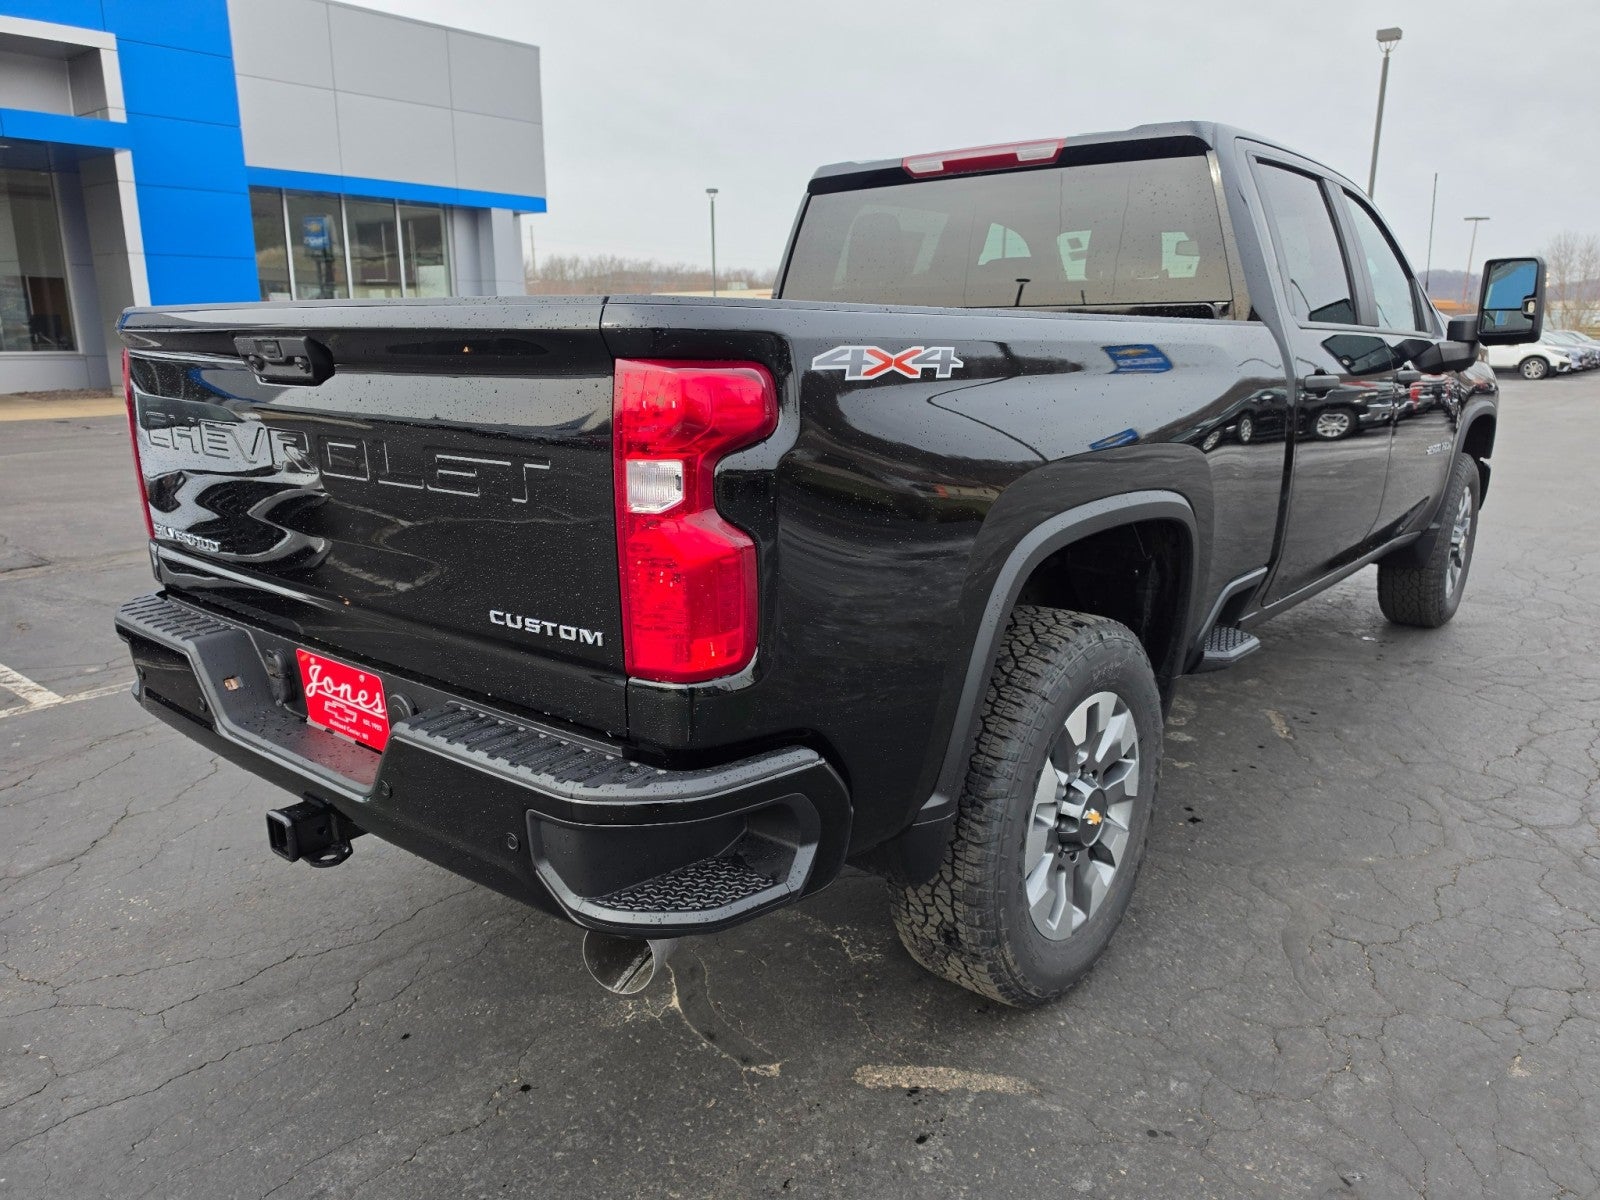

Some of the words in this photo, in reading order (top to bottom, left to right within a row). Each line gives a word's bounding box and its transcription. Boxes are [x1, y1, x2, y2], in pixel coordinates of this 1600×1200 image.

[146, 411, 550, 504] CHEVROLET
[489, 609, 604, 647] CUSTOM
[306, 665, 385, 713] Jones
